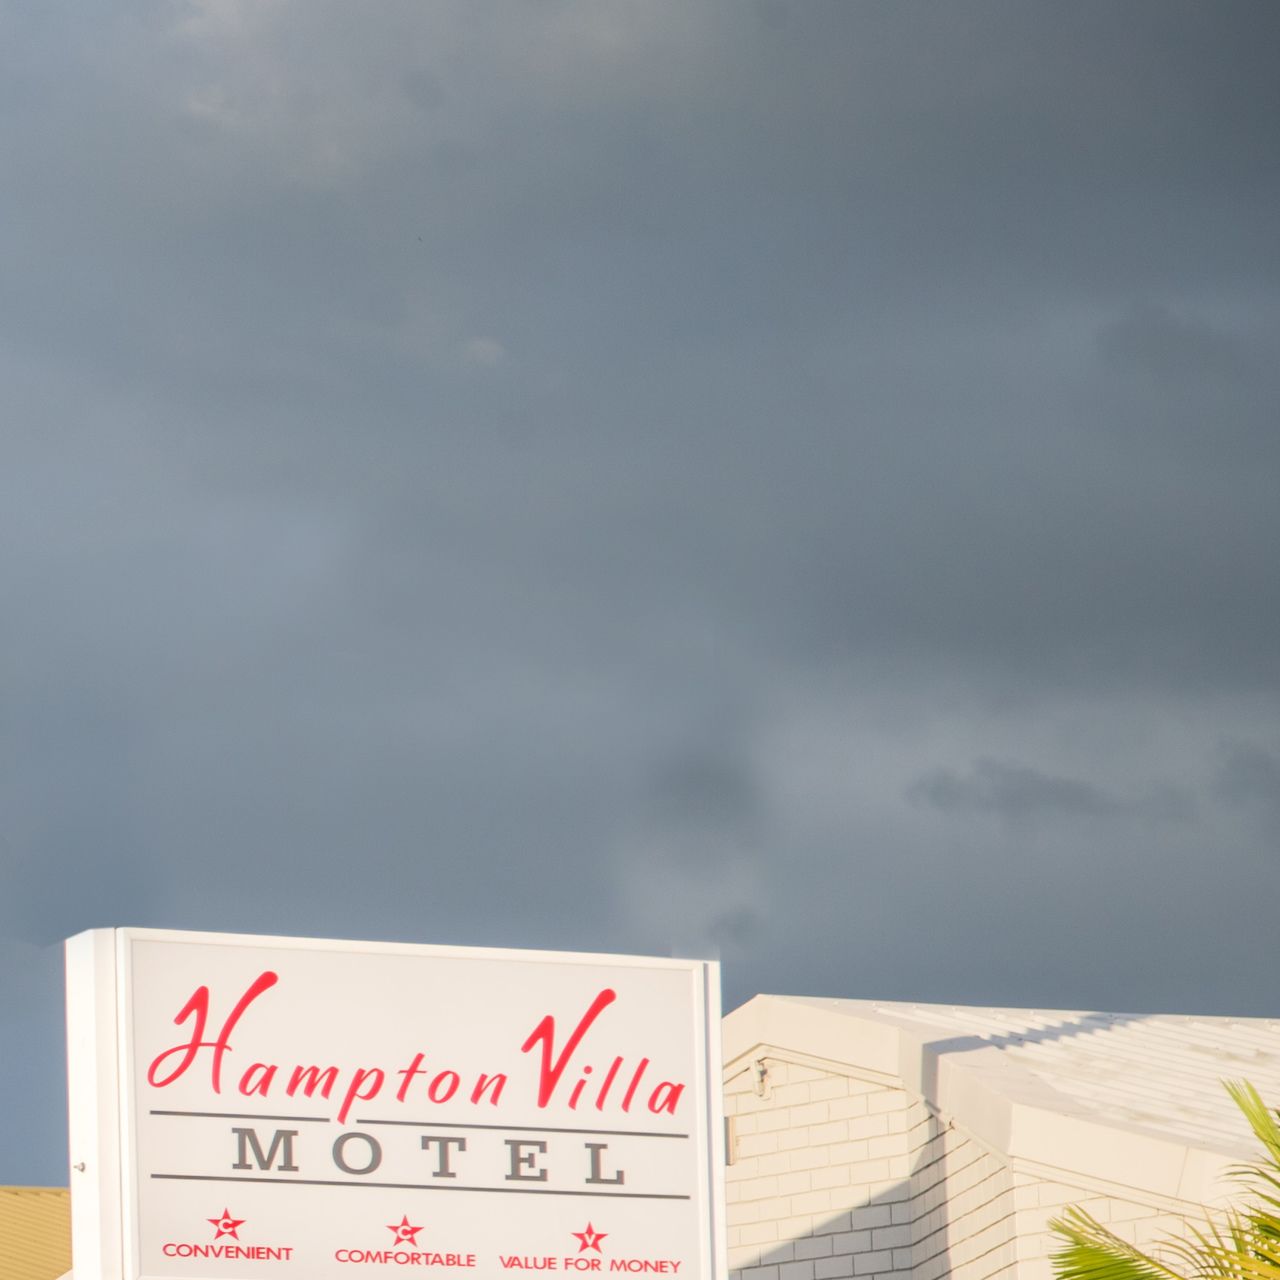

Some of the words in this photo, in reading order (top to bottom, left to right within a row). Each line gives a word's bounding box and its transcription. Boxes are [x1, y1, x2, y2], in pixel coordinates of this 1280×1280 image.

[147, 970, 508, 1125] Hampton
[521, 988, 686, 1116] Villa
[231, 1126, 626, 1185] MOTEL
[162, 1242, 294, 1262] CONVENIENT
[334, 1249, 477, 1268] COMFORTABLE
[500, 1254, 559, 1271] VALUE
[564, 1256, 602, 1272] FOR
[609, 1257, 682, 1275] MONEY
